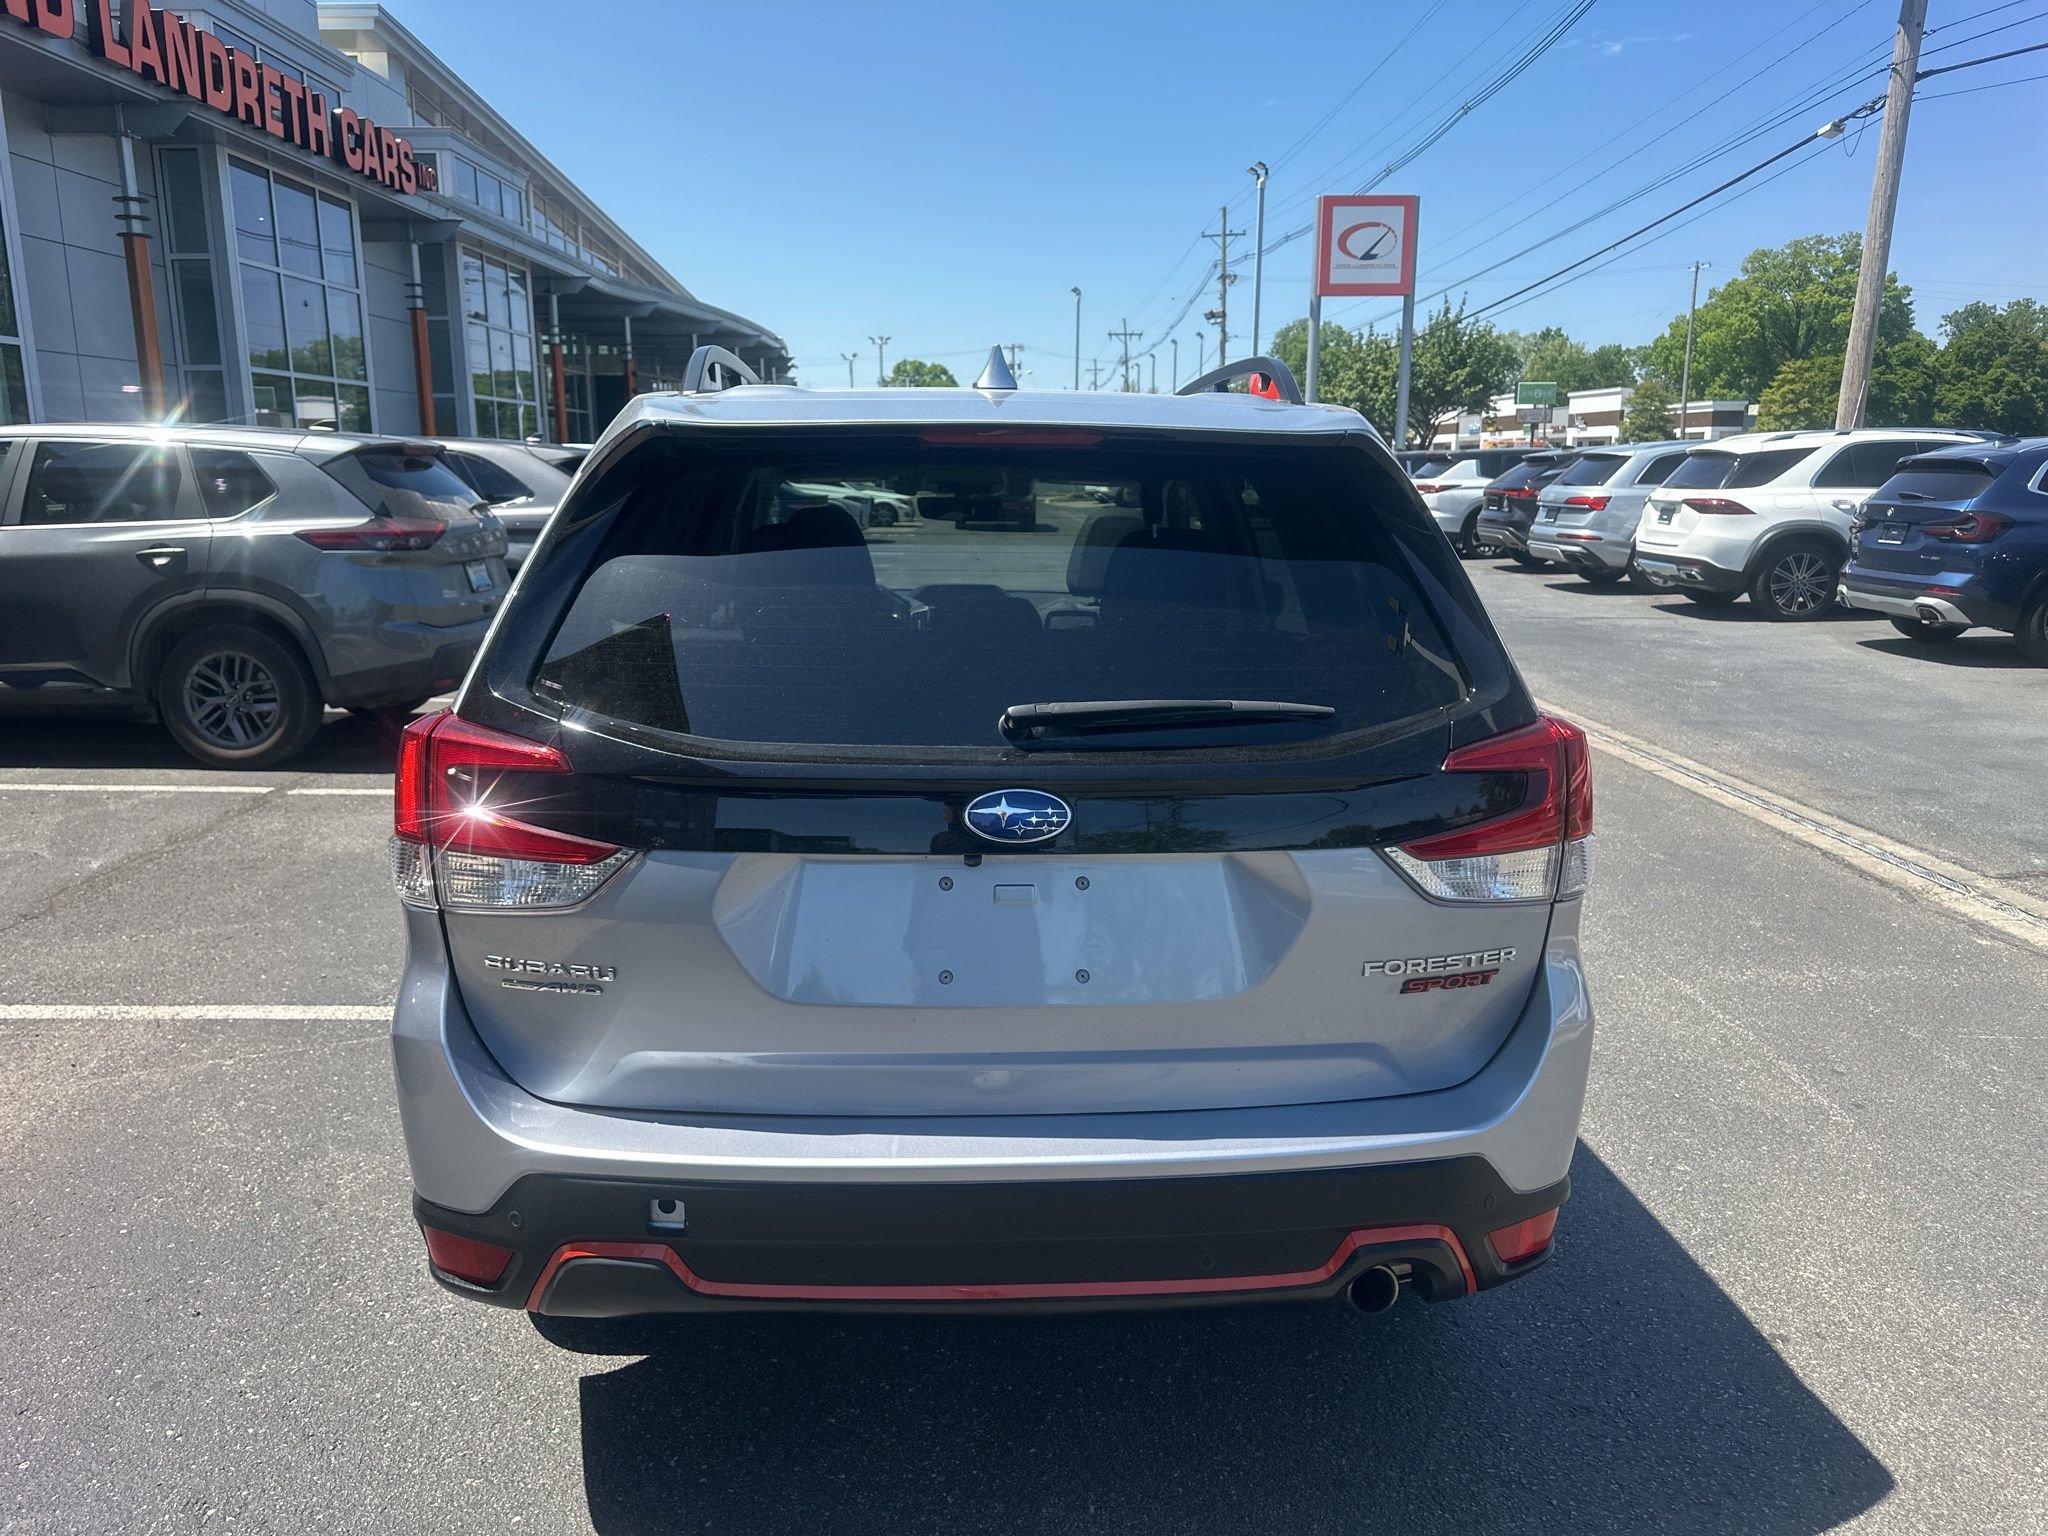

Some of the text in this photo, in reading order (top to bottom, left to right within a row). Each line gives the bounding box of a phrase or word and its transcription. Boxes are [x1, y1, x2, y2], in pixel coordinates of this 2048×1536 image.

[97, 0, 330, 157] LANDRETH
[338, 106, 416, 195] CARS
[483, 954, 616, 982] SUBARU
[1362, 946, 1517, 977] FORESTER
[1401, 969, 1500, 994] SPORT
